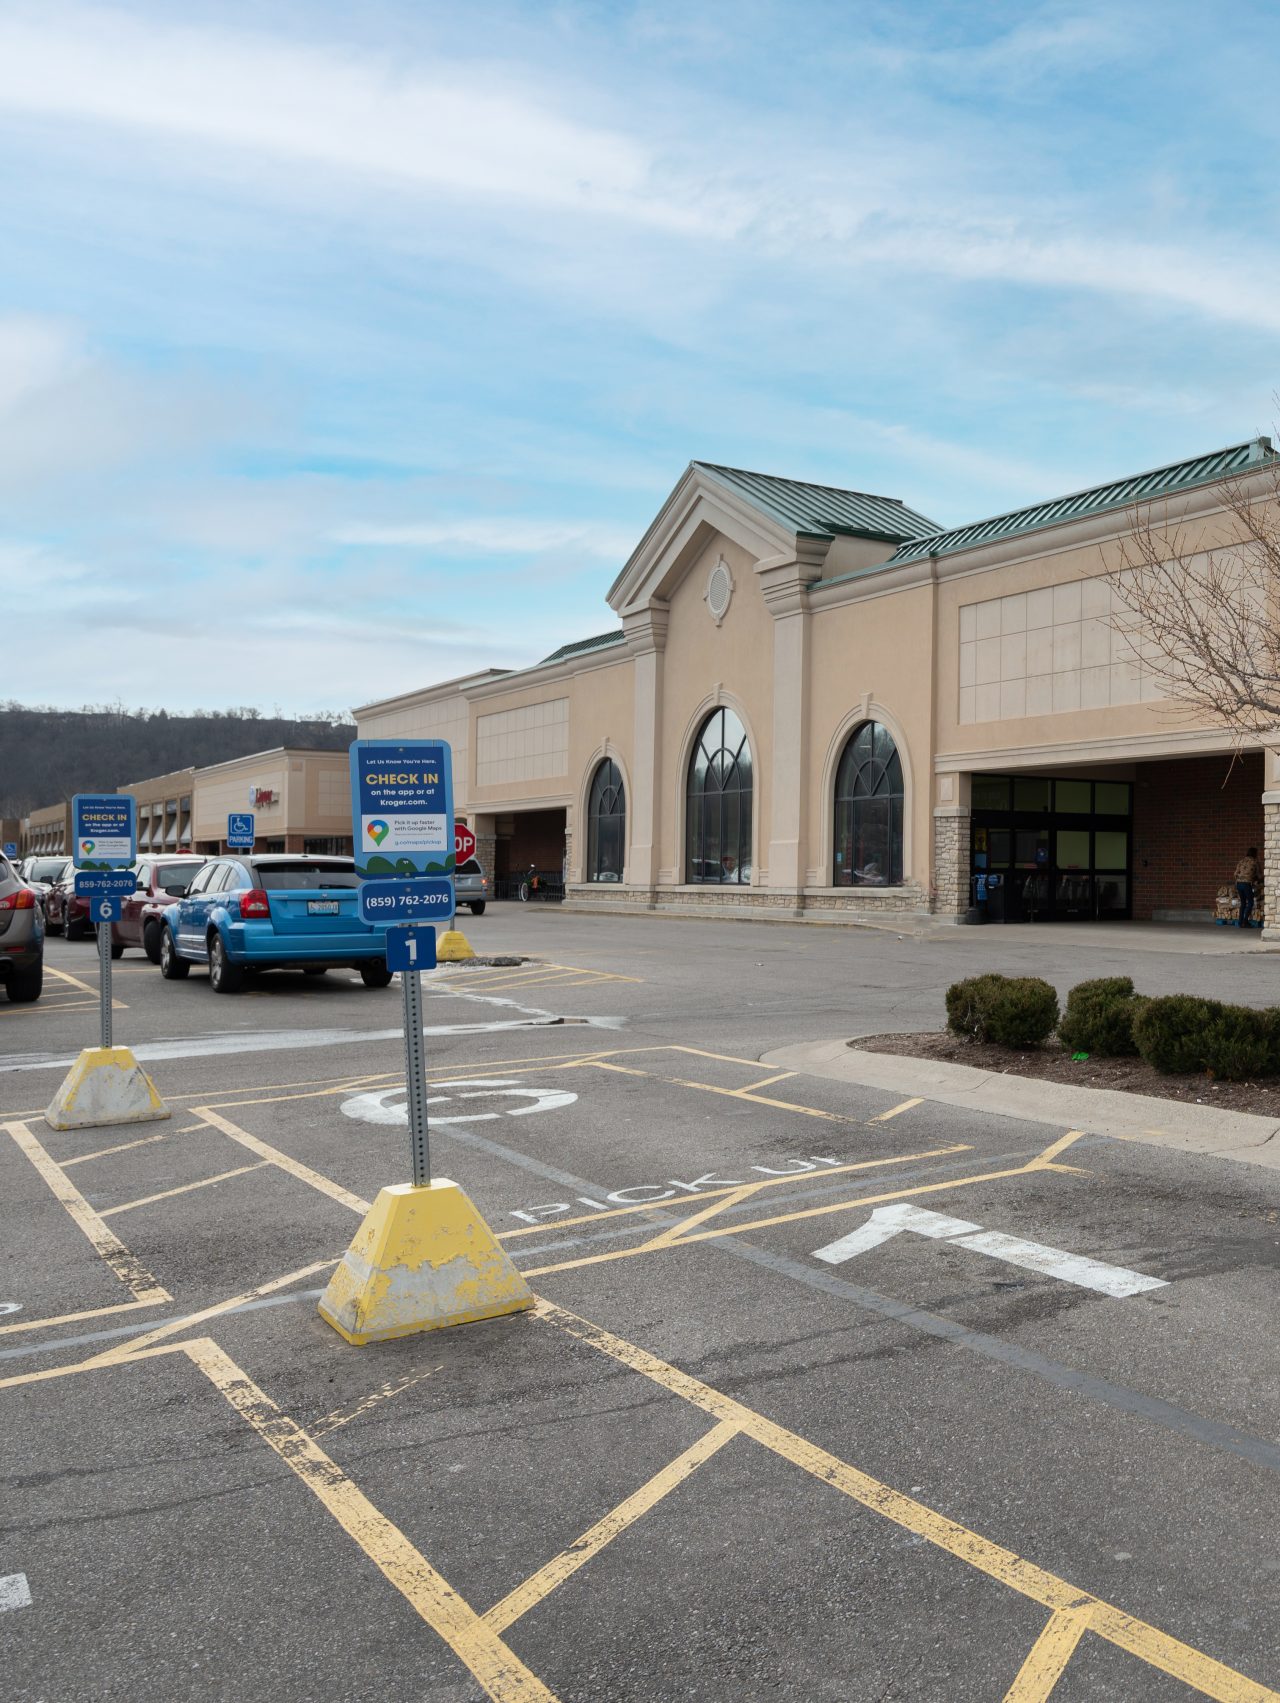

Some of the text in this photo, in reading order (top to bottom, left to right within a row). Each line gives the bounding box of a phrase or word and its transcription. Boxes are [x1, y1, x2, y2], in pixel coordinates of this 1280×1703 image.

[366, 773, 439, 785] CHECK IN
[380, 799, 428, 807] Kroger.com.
[455, 836, 473, 852] OP
[79, 880, 133, 889] 859-762-2076
[366, 894, 449, 909] (859) 762-2076
[99, 902, 113, 918] 6
[404, 939, 417, 961] 1
[509, 1172, 746, 1224] PICK
